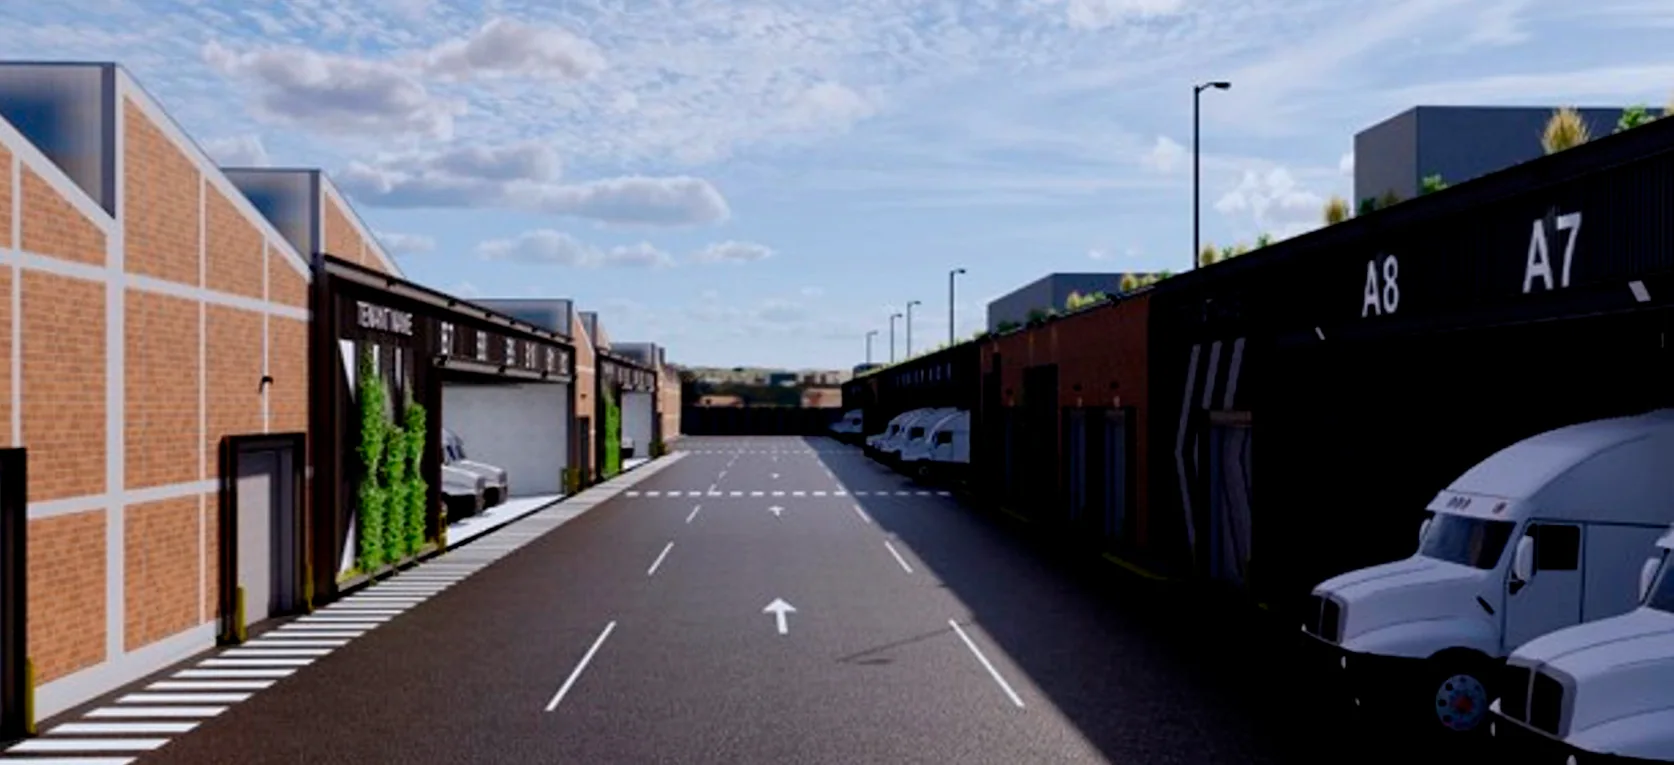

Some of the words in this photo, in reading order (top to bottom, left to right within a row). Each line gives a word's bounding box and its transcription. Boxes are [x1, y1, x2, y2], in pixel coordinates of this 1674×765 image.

[1522, 211, 1582, 293] A7
[356, 300, 391, 331] TENANT
[391, 308, 413, 336] NAME
[1361, 254, 1399, 318] A8
